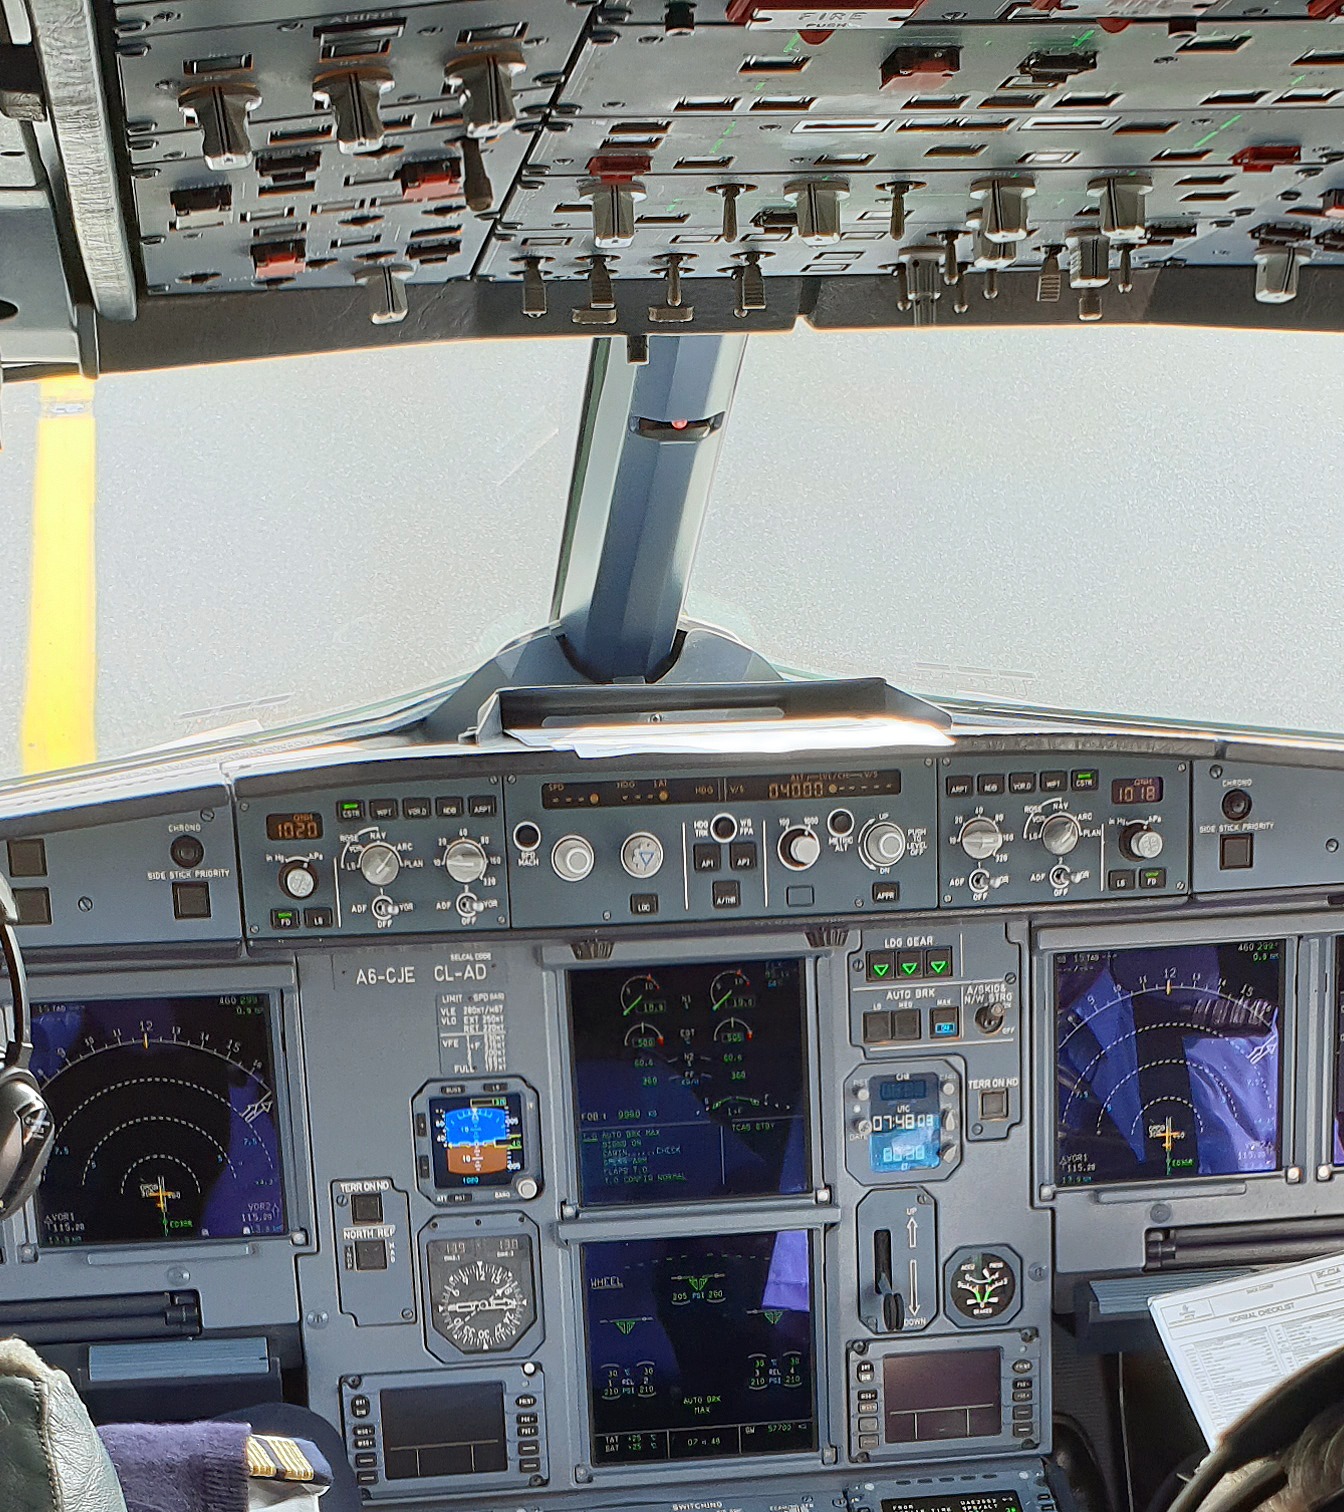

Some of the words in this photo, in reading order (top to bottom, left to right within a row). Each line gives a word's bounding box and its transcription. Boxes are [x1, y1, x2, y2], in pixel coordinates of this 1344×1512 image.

[798, 12, 867, 21] FIRE
[1222, 779, 1252, 787] CHRONO
[768, 782, 824, 798] 04000
[1119, 787, 1155, 801] 1018
[1053, 802, 1068, 810] NAV
[878, 812, 889, 820] UP
[1078, 812, 1093, 821] ARC
[168, 824, 201, 833] CHRONO
[277, 821, 318, 839] 1020
[1242, 822, 1274, 831] PRIORITY
[370, 832, 386, 840] NAV
[908, 828, 927, 836] PUSH
[1083, 829, 1101, 837] PLAN
[397, 843, 413, 851] ARC
[834, 844, 848, 852] ALT
[907, 842, 928, 850] LEVEL
[910, 848, 924, 856] OFF
[404, 860, 424, 868] PLAN
[518, 858, 539, 867] MACH
[701, 859, 714, 868] AP1
[147, 871, 166, 881] SIDE
[170, 871, 191, 879] STICK
[195, 869, 230, 878] PRIORITY
[880, 867, 890, 875] DN
[1030, 873, 1046, 881] ADF
[949, 878, 964, 887] ADF
[973, 892, 988, 901] OFF
[1053, 888, 1068, 897] OFF
[351, 904, 367, 913] ADF
[436, 902, 451, 910] ADF
[637, 903, 651, 912] LOC
[377, 920, 392, 928] OFF
[461, 917, 476, 926] OFF
[884, 937, 903, 949] LDG
[906, 936, 933, 947] GEAR
[1238, 943, 1254, 951] 460
[451, 953, 473, 961] SELCAL
[356, 966, 415, 985] A6-CJE
[434, 964, 487, 982] CL-AD
[1163, 968, 1176, 979] 12
[442, 994, 463, 1003] LIMIT
[473, 994, 488, 1002] SPD
[886, 990, 911, 1000] AUTO
[915, 989, 936, 998] BRK
[964, 994, 984, 1004] N/W
[441, 1008, 456, 1016] VLE
[441, 1017, 456, 1025] VLO
[464, 1016, 479, 1024] EXT
[139, 1021, 153, 1032] 12
[464, 1025, 479, 1033] RET
[112, 1029, 122, 1037] 11
[228, 1039, 240, 1053] 15
[442, 1040, 459, 1048] VFE
[454, 1065, 474, 1073] FULL
[968, 1080, 991, 1090] TERR
[992, 1079, 1005, 1088] ON
[1006, 1077, 1019, 1087] ND
[897, 1105, 910, 1113] UTC
[602, 1130, 622, 1139] AUTO
[462, 1155, 471, 1163] 10
[340, 1182, 363, 1193] TERR
[364, 1183, 376, 1192] ON
[377, 1182, 389, 1191] ND
[906, 1207, 917, 1216] UP
[343, 1229, 373, 1240] NORTH
[476, 1271, 486, 1281] 12
[591, 1276, 621, 1288] WHEEL
[1229, 1312, 1257, 1322] NORMAL
[1258, 1302, 1295, 1317] CHECKLIST
[904, 1317, 926, 1326] DOWN
[750, 1377, 765, 1385] 210
[683, 1397, 702, 1405] AUTO
[694, 1406, 711, 1415] MAX
[606, 1436, 619, 1444] TAT
[672, 1502, 723, 1511] SWITCHING
